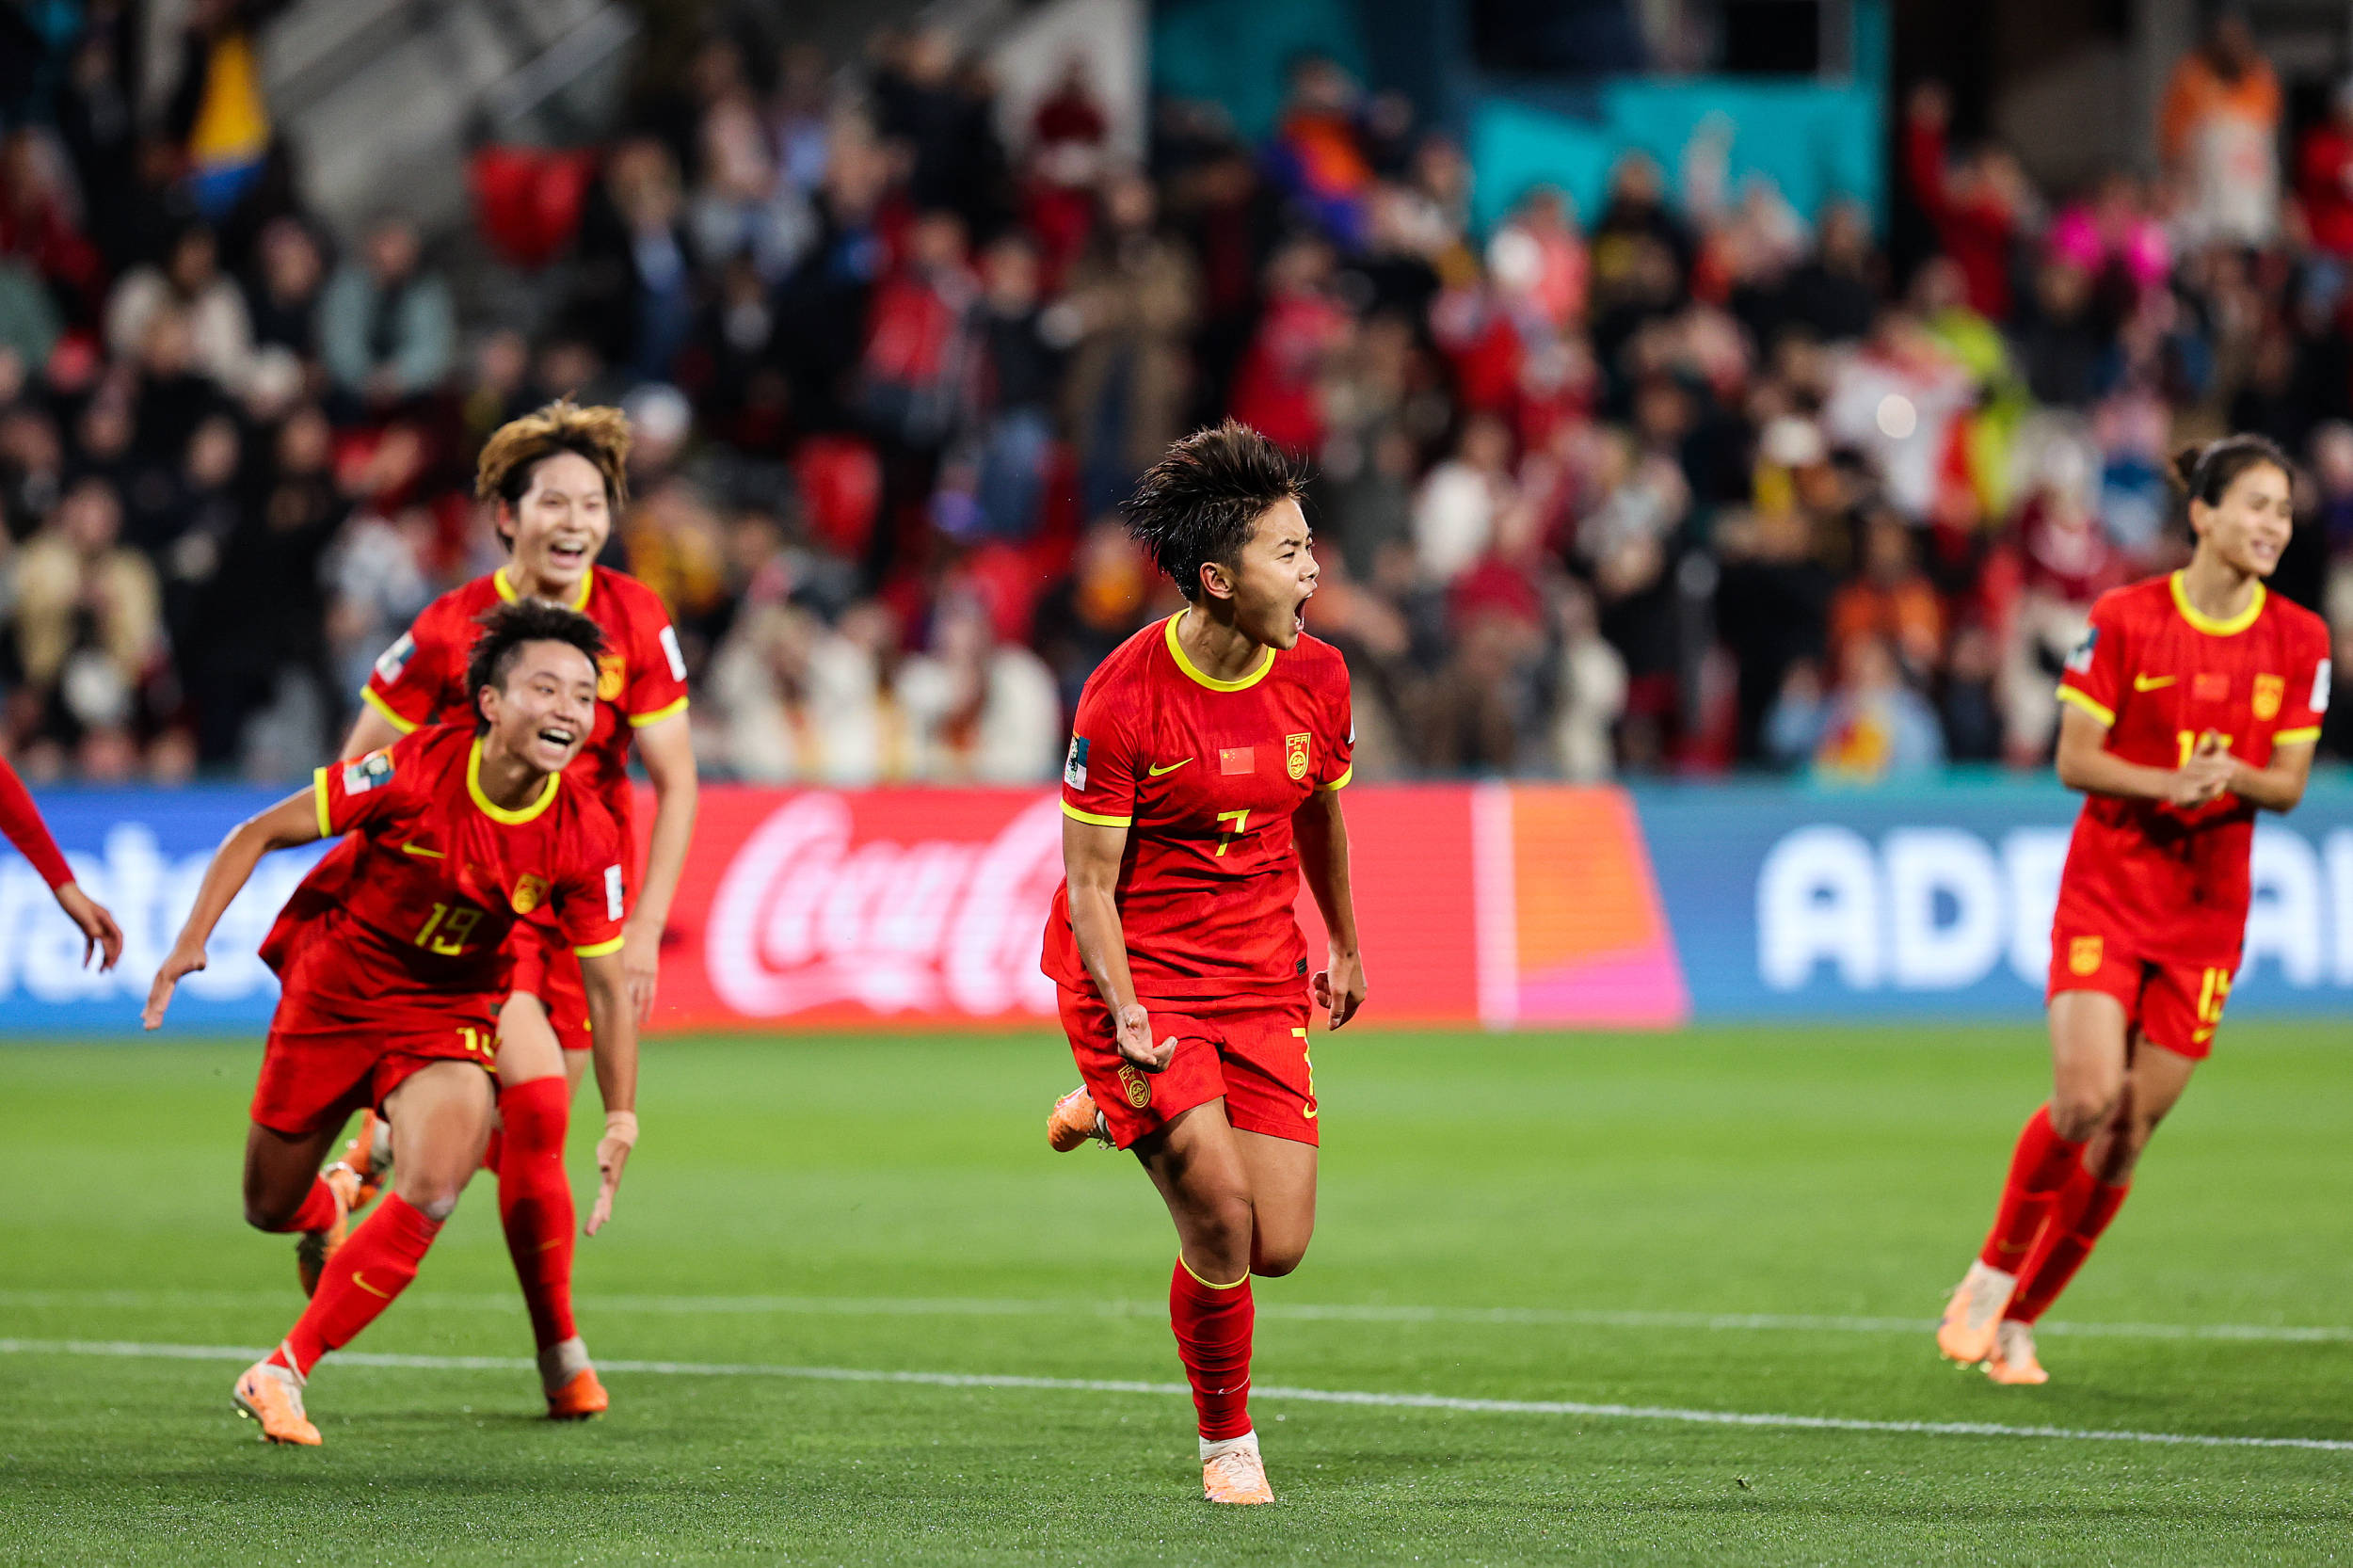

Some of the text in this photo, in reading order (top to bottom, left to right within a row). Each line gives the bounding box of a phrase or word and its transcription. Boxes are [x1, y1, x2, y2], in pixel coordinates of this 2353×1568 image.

[1289, 735, 1308, 746] CFA
[1215, 808, 1251, 857] 7
[414, 902, 484, 956] 19
